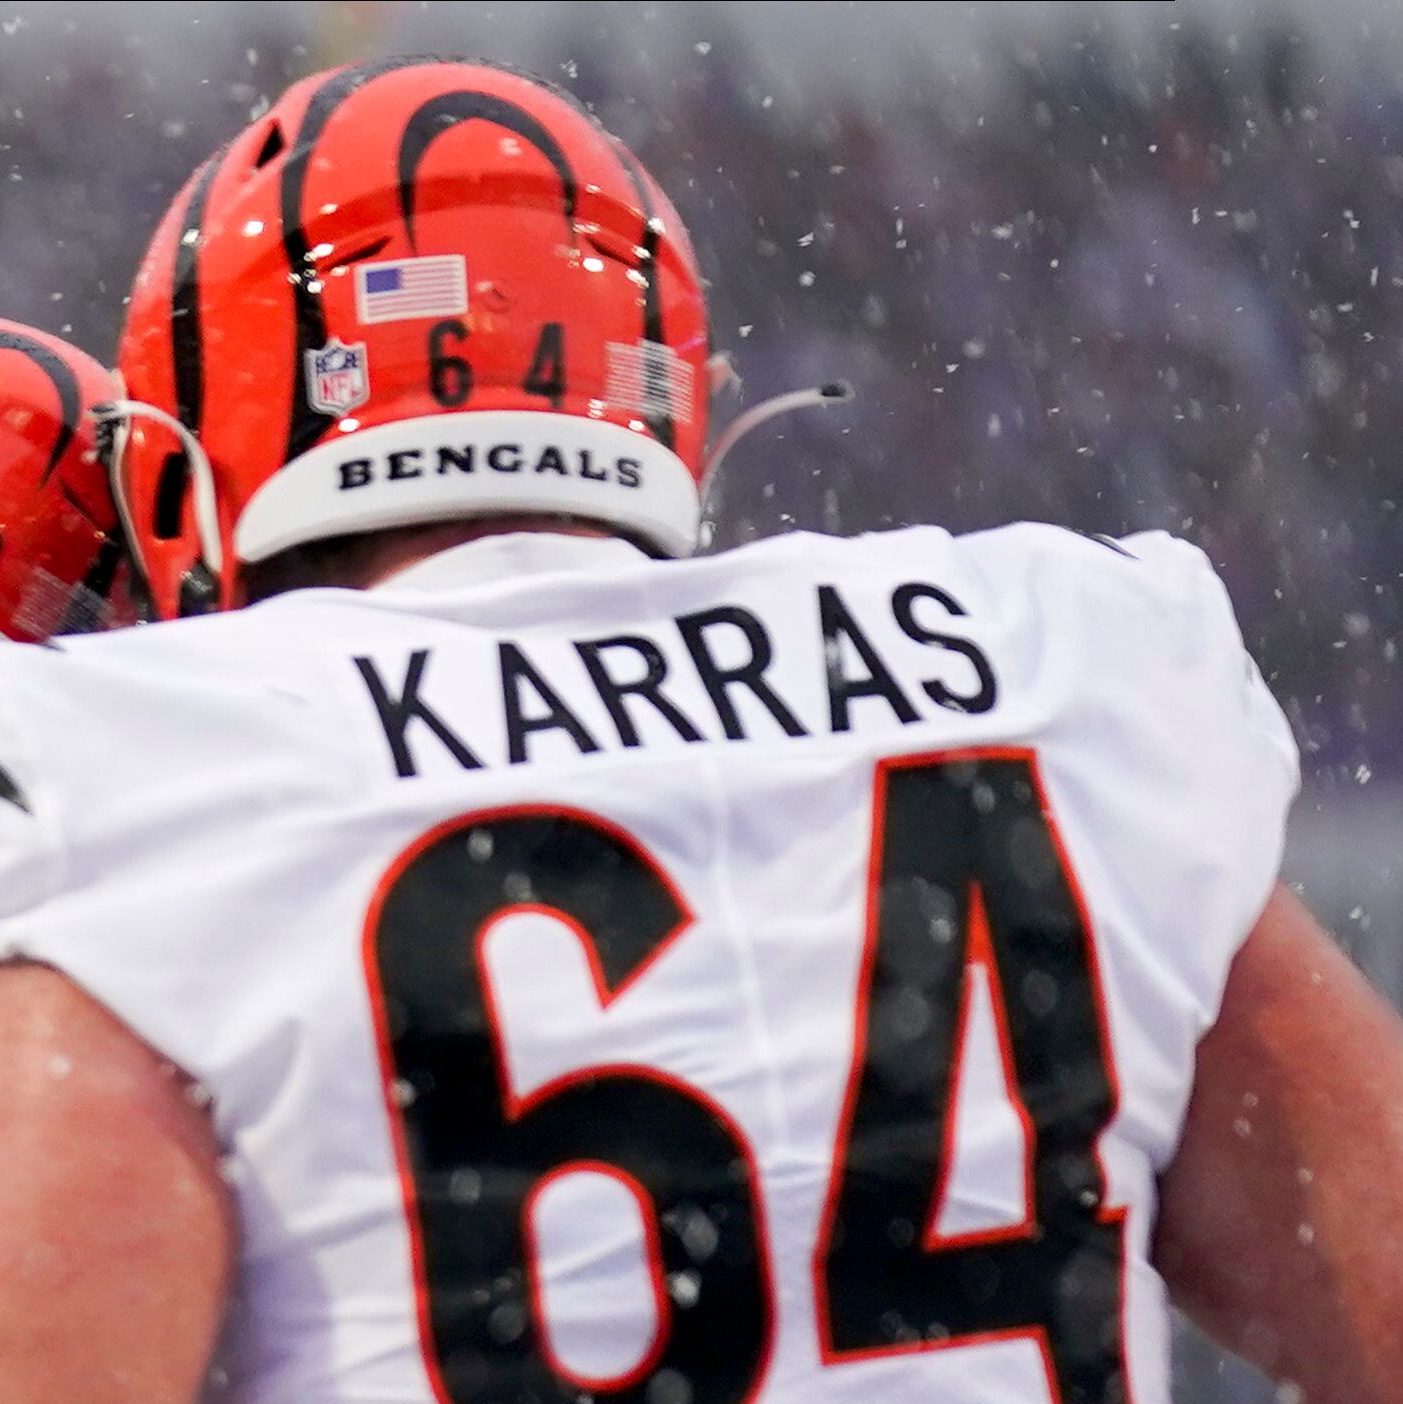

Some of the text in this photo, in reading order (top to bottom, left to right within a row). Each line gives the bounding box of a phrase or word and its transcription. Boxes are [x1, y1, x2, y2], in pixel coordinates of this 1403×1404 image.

[320, 373, 362, 402] NFL
[428, 319, 566, 408] 64
[338, 444, 643, 491] BENGALS
[352, 581, 1000, 778] KARRAS
